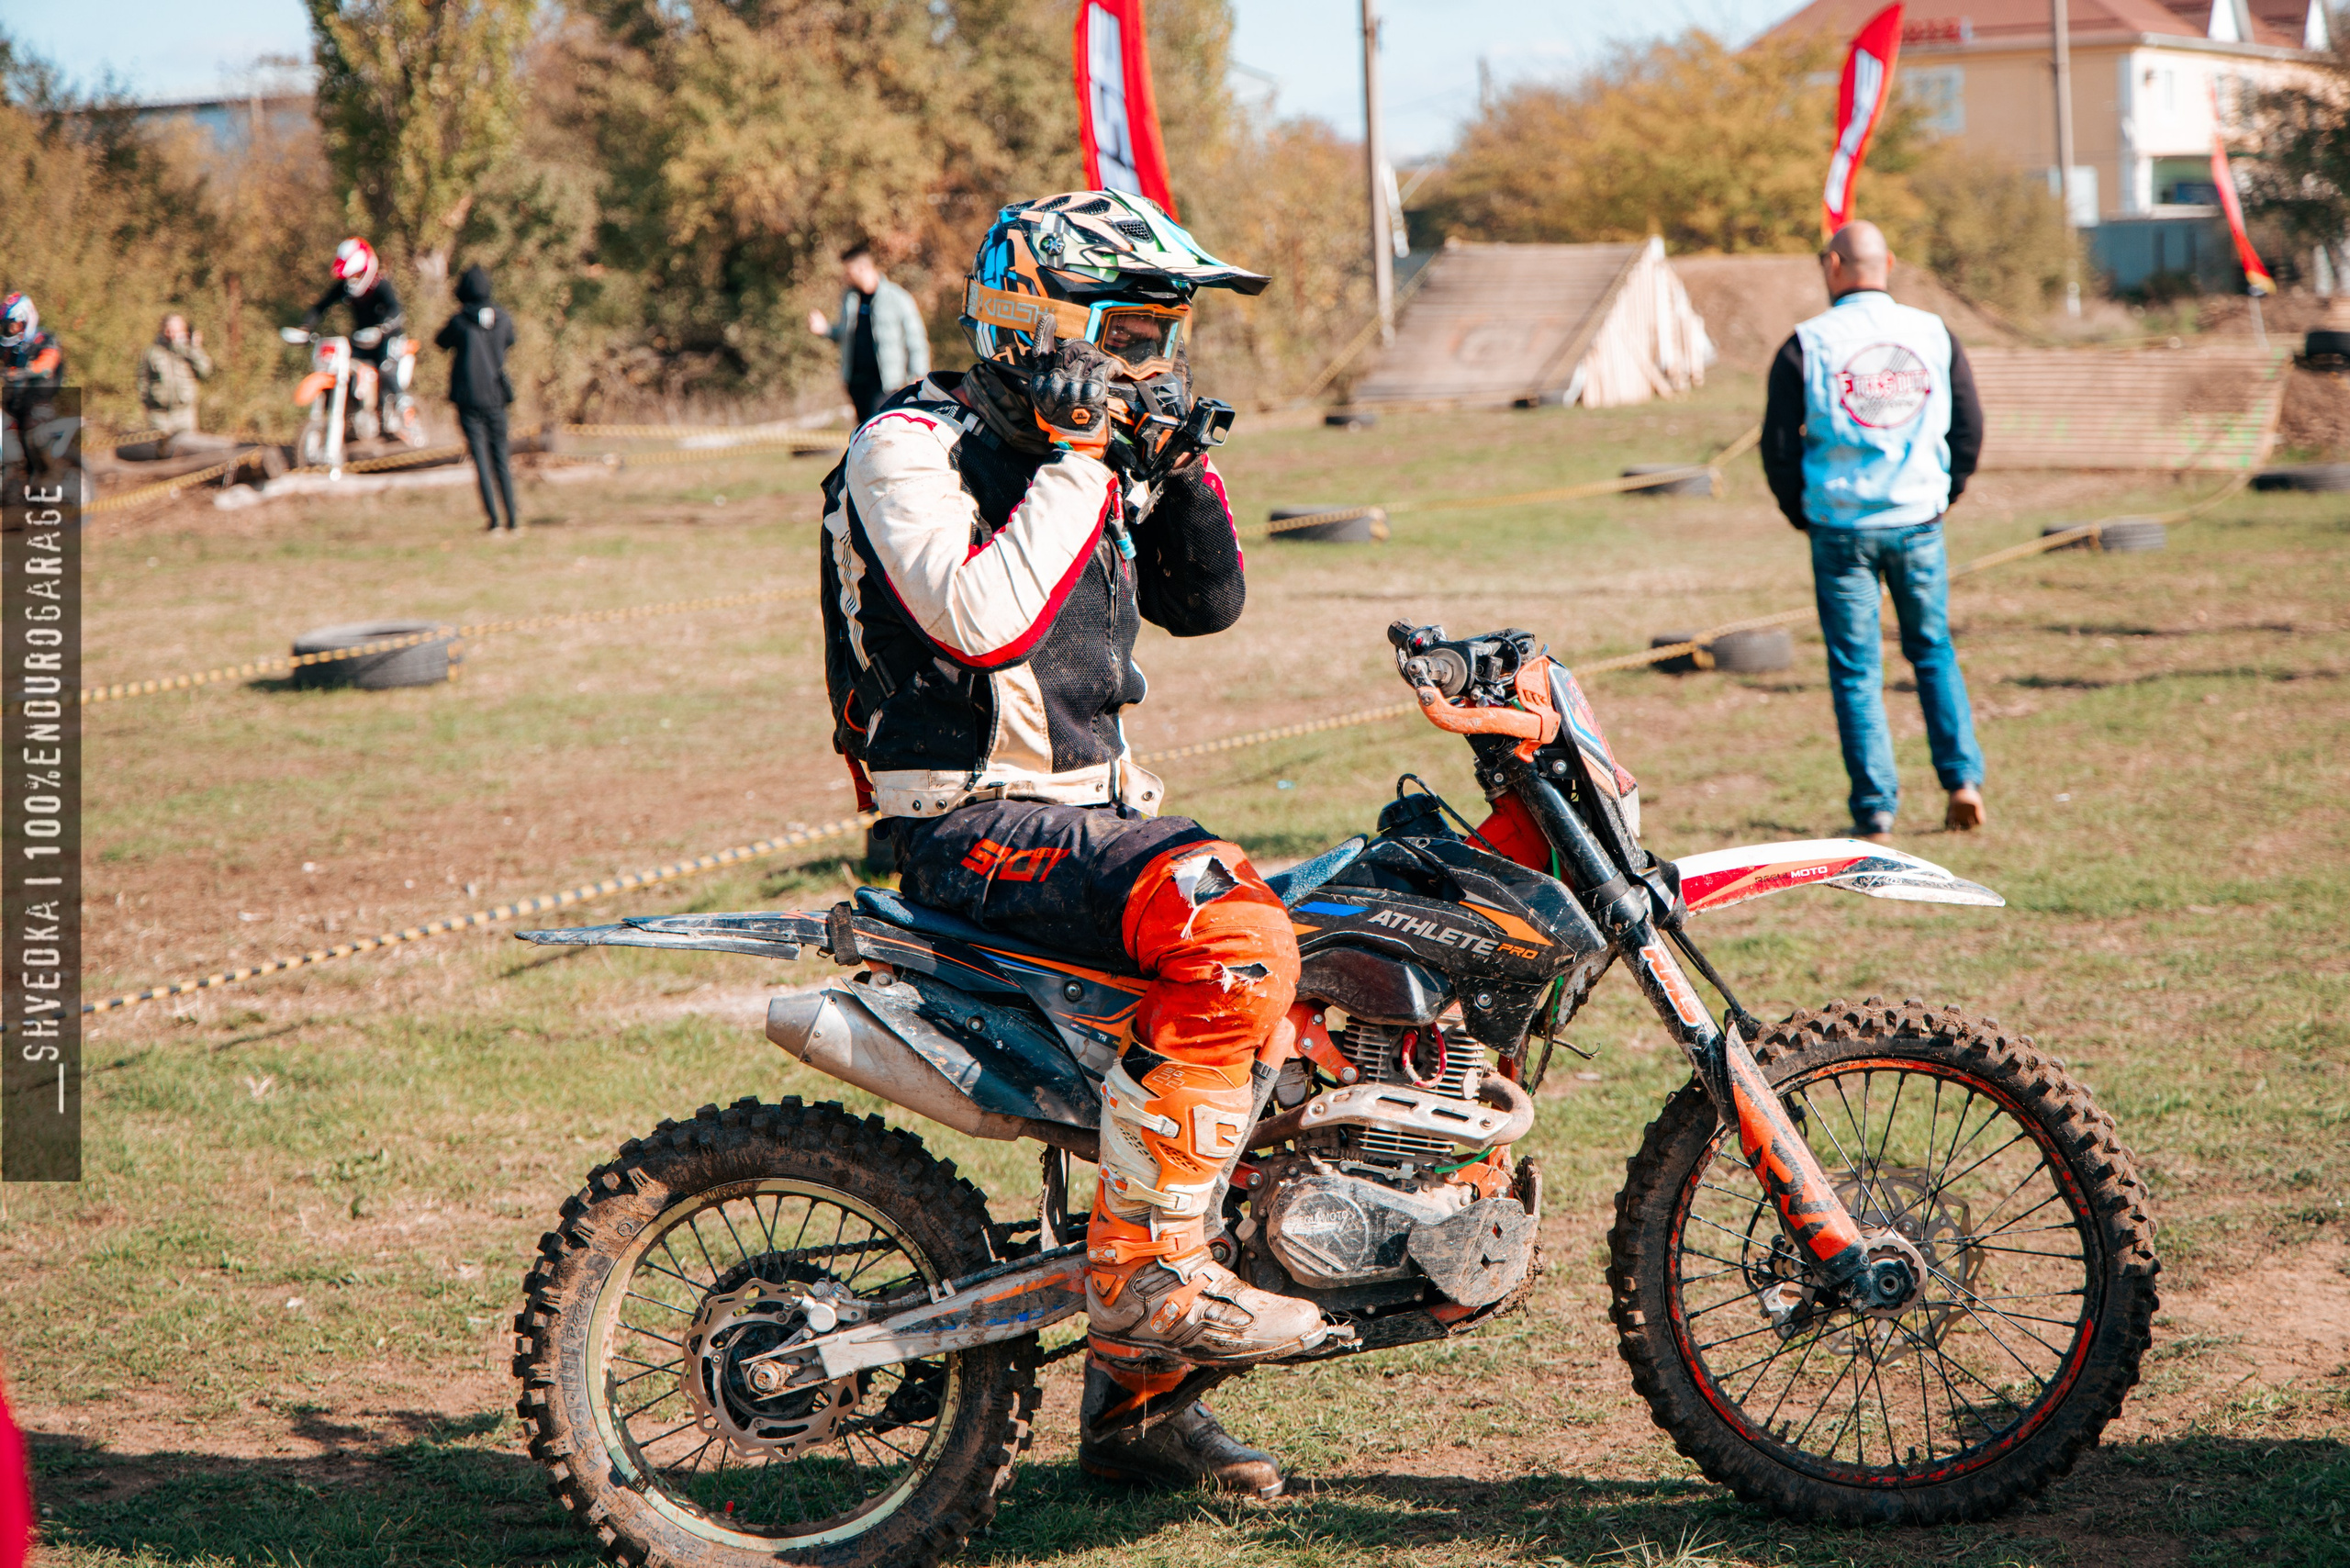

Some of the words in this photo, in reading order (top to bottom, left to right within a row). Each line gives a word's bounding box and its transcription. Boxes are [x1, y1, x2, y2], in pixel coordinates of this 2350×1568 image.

[979, 292, 1055, 325] KIOSH
[1368, 909, 1500, 957] ATHLETE
[1496, 942, 1539, 960] PRO
